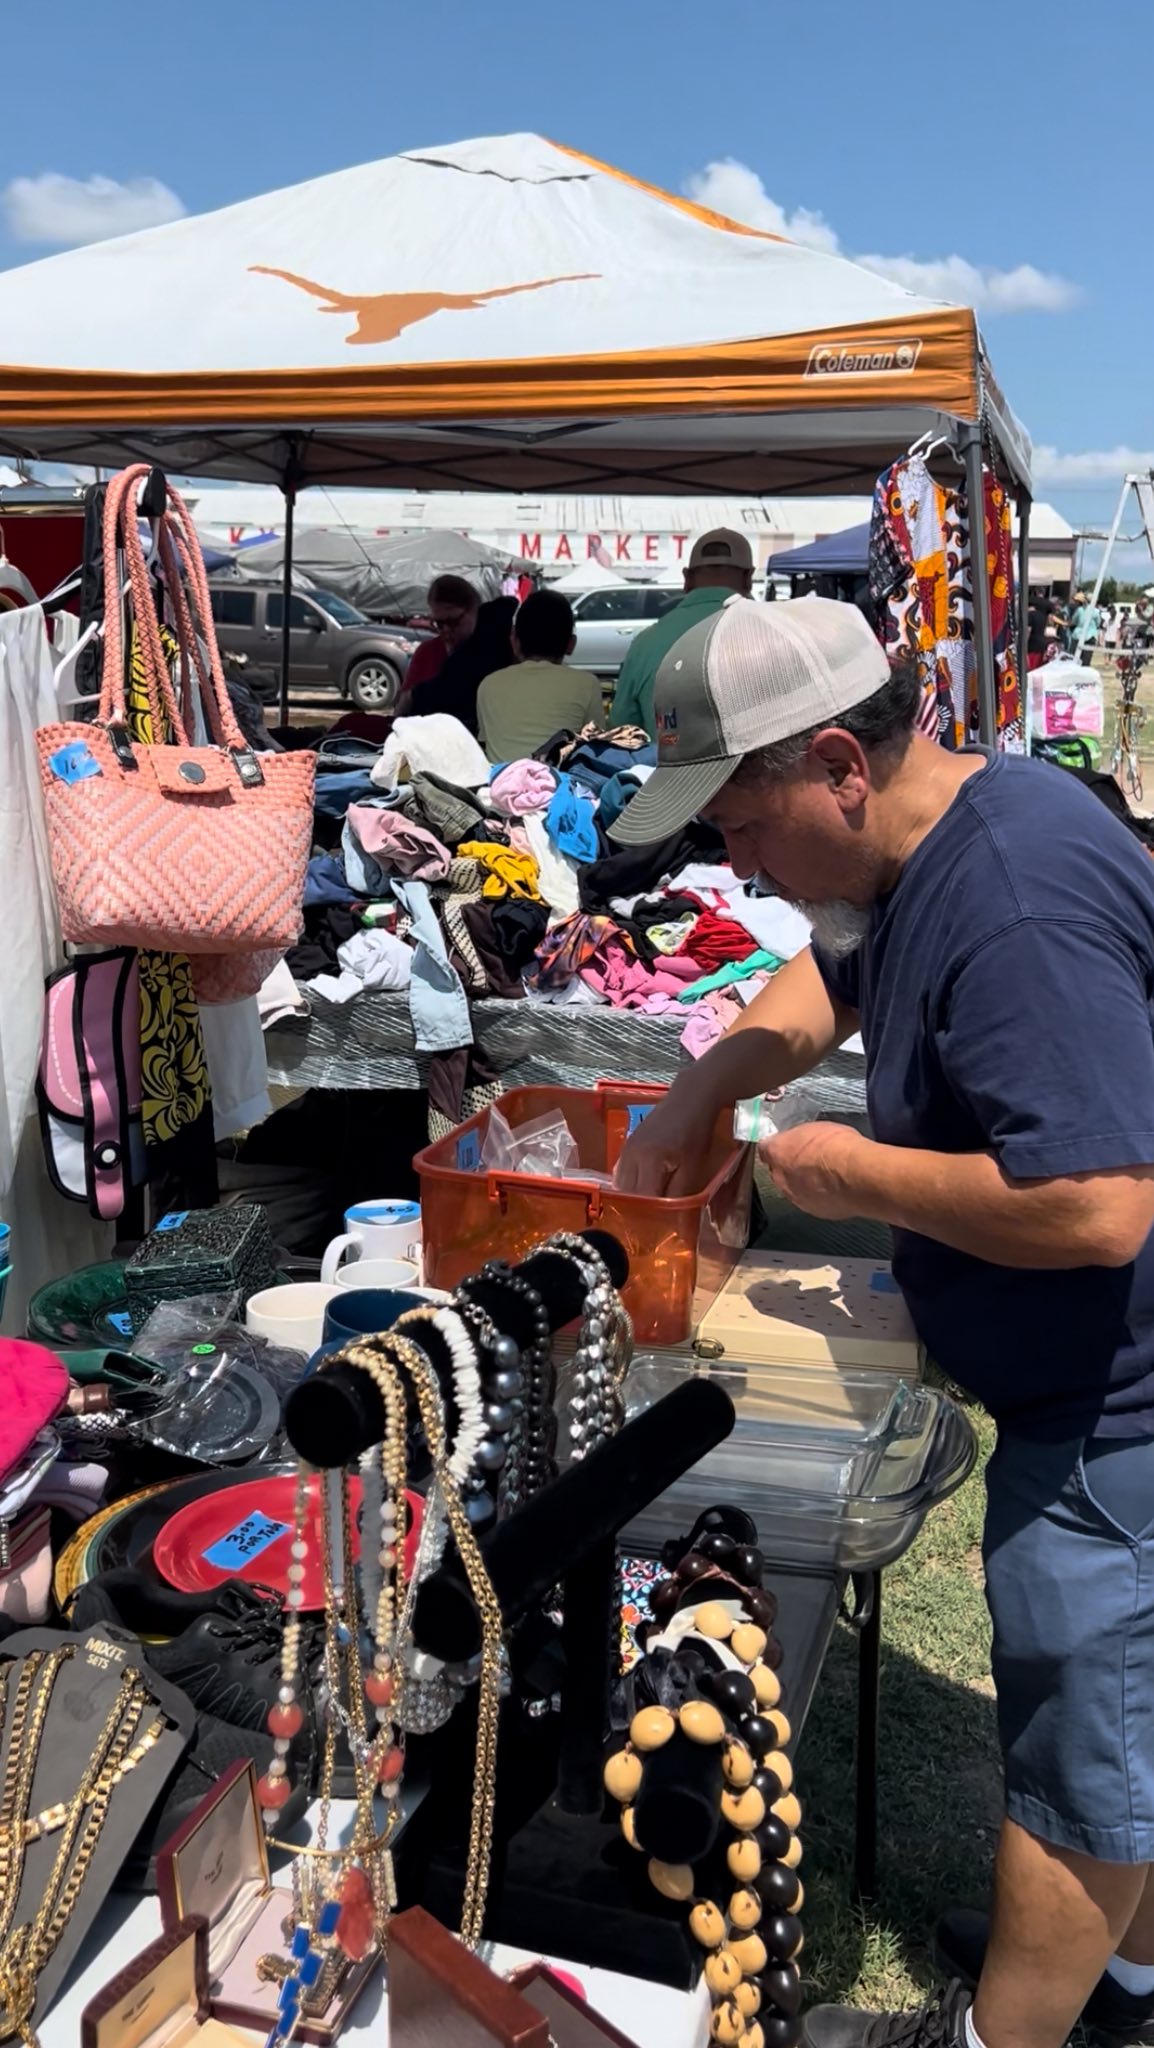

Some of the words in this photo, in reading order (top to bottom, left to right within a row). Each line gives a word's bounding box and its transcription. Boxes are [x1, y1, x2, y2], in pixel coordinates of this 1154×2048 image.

[814, 347, 895, 373] Coleman
[519, 533, 689, 561] MARKET
[225, 1521, 255, 1545] 3.00
[86, 1653, 110, 1669] SETS
